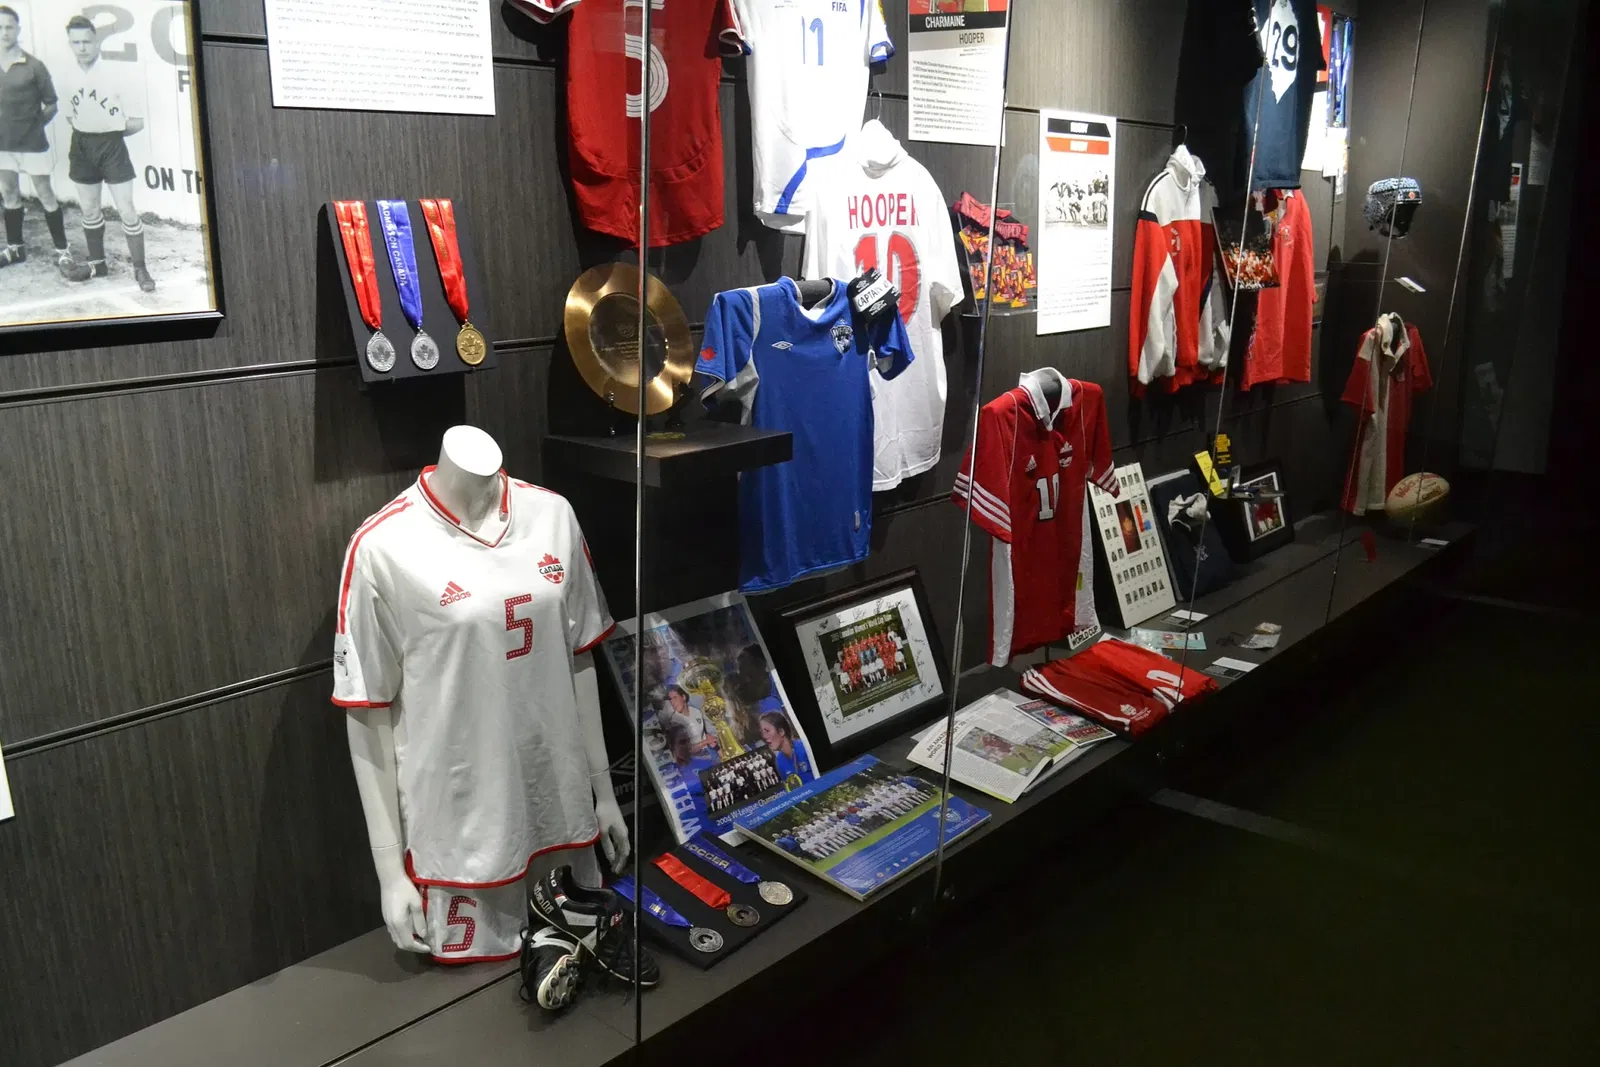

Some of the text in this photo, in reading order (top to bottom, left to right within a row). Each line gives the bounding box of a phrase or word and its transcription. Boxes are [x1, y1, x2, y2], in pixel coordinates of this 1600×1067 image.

[830, 2, 848, 13] FIFA
[925, 15, 966, 28] CHARMAINE
[958, 32, 986, 44] HOOPER
[1271, 21, 1298, 71] 29
[144, 165, 175, 192] ON
[392, 250, 408, 287] CANADA
[439, 591, 472, 607] adidas
[505, 594, 534, 660] 5
[1087, 625, 1099, 638] CUP
[686, 842, 730, 869] OCCER
[442, 896, 477, 953] 5
